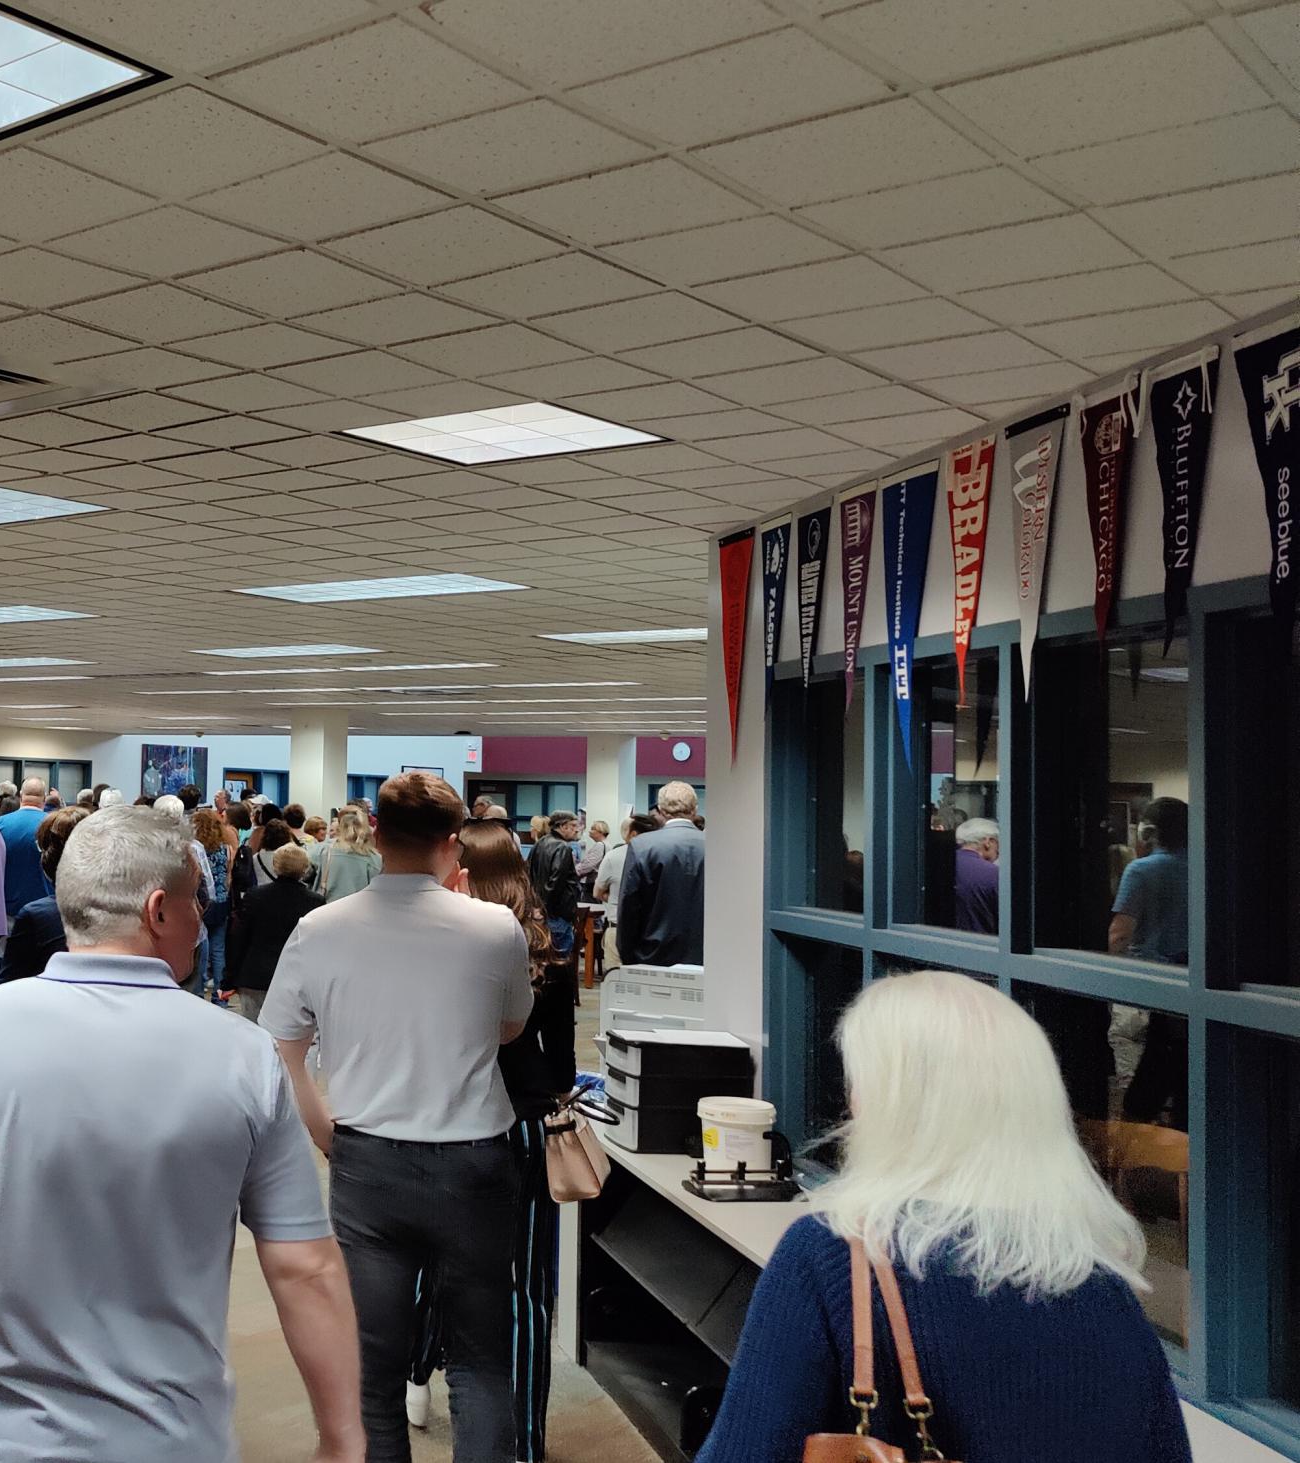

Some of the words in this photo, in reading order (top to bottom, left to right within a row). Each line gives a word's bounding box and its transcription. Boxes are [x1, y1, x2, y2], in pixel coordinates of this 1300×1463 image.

[1033, 436, 1051, 541] WESTERN
[1174, 423, 1192, 568] BLUFFTON
[897, 509, 906, 575] Technical
[952, 463, 989, 645] BRADLEY
[1020, 491, 1034, 600] COLORADO
[1097, 461, 1109, 592] CHICAGO
[802, 605, 815, 634] STATE
[848, 555, 864, 615] MOUNT
[894, 580, 903, 639] Institute
[766, 586, 777, 667] FALCONS
[846, 621, 858, 673] UNION
[895, 644, 909, 700] ITT
